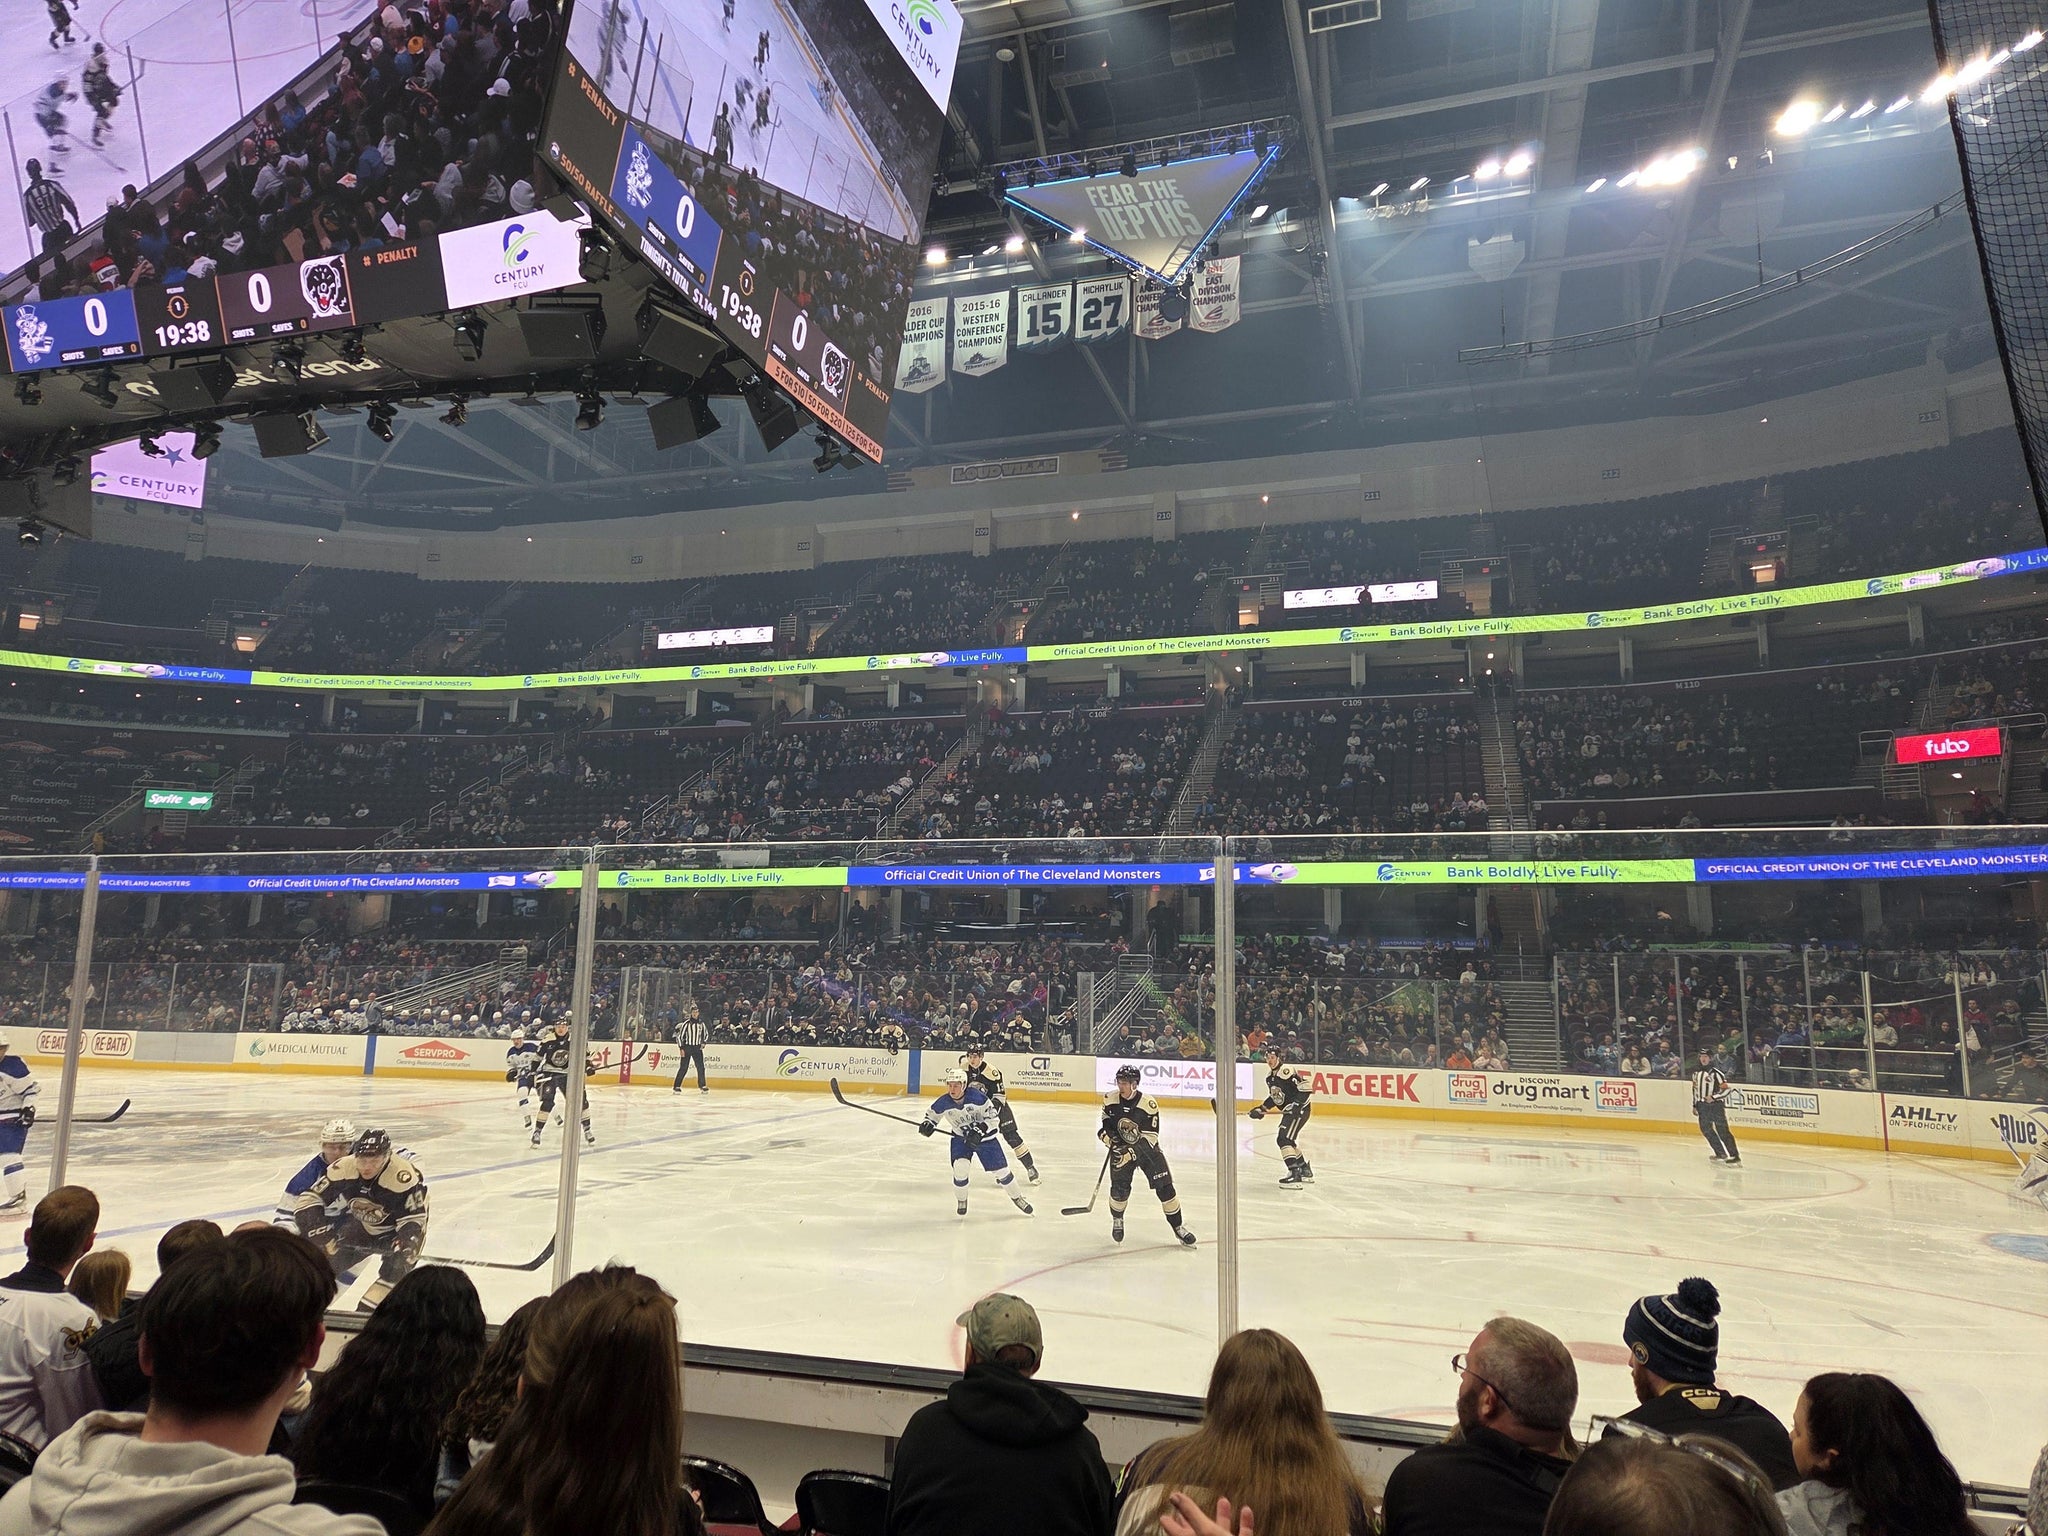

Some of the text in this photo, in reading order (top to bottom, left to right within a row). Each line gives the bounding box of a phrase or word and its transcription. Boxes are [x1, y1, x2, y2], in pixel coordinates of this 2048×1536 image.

[891, 3, 941, 79] CENTURY
[906, 43, 921, 69] FCU
[580, 77, 617, 126] PENALTY
[560, 154, 614, 218] 50/50 RAFFLE
[1085, 179, 1184, 207] FEAR THE
[676, 195, 695, 239] 0
[1094, 199, 1204, 241] DEPTHS
[377, 246, 418, 265] PENALTY
[494, 264, 545, 285] CENTURY
[671, 267, 690, 295] TOTAL
[1206, 275, 1223, 285] EAST
[248, 272, 271, 313] 0
[513, 281, 528, 290] FCU
[1083, 282, 1124, 295] MICHAYLUK
[1198, 284, 1231, 296] DIVISION
[1022, 289, 1067, 302] CALLANDER
[1193, 292, 1236, 306] CHAMPIONS
[721, 285, 762, 339] 19:38
[910, 306, 932, 317] 2016
[962, 299, 1001, 313] 2015-16
[1082, 295, 1123, 331] 27
[84, 298, 108, 336] 0
[929, 317, 945, 329] CUP
[963, 313, 1000, 326] WESTERN
[1026, 302, 1062, 337] 15
[155, 320, 210, 347] 19:38
[232, 327, 255, 338] SHOTS
[792, 314, 807, 351] 0
[956, 323, 1005, 337] CONFERENCE
[958, 335, 1003, 348] CHAMPIONS
[62, 351, 85, 361] SHOTS
[865, 378, 890, 404] PENALTY
[780, 370, 794, 388] FOR
[807, 396, 817, 411] 50
[817, 402, 830, 421] FOR
[845, 425, 856, 442] 125
[856, 433, 868, 450] FOR
[119, 475, 199, 496] CENTURY
[147, 490, 169, 500] FCU
[1157, 512, 1171, 520] 210
[975, 528, 989, 536] 209
[1644, 609, 1673, 620] Bank
[1676, 604, 1718, 616] Boldly.
[1721, 601, 1747, 610] Live
[1750, 594, 1785, 606] Fully.
[1390, 627, 1416, 637] Bank
[1419, 624, 1455, 636] Boldly.
[1458, 623, 1480, 633] Live
[1483, 621, 1513, 632] Fully.
[1053, 635, 1271, 656] Official Credit Union of The Cleveland Monsters
[961, 653, 979, 662] Live
[981, 651, 1005, 662] Fully.
[1925, 739, 1970, 755] fubo
[149, 793, 183, 804] Sprite
[1707, 853, 2048, 874] OFFICIAL CREDIT UNION OF THE CLEVELAND MONSTER
[664, 874, 690, 883] Bank
[693, 873, 729, 885] Boldly.
[731, 873, 754, 883] Live
[756, 872, 785, 884] Fully.
[884, 867, 1161, 881] Official Credit Union of The Cleveland Monsters
[1447, 866, 1483, 878] Bank
[1488, 866, 1540, 880] Boldly.
[1545, 866, 1576, 877] Live
[1581, 865, 1622, 879] Fully.
[12, 876, 42, 884] CREDIT
[43, 877, 69, 885] UNION
[69, 877, 79, 885] OF
[109, 879, 149, 887] CLEVELAND
[149, 880, 191, 888] MONSTERS
[248, 876, 460, 888] Official Credit Union of The Cleveland Monsters
[95, 1035, 128, 1051] RE-BATH
[267, 1042, 348, 1055] MEDICAL MUTUAL
[801, 1061, 847, 1071] CENTURY
[849, 1056, 898, 1067] Bank Boldly.
[848, 1067, 888, 1077] Live Fully.
[1018, 1070, 1049, 1078] CONSUMER
[1451, 1077, 1481, 1090] drug
[1519, 1077, 1561, 1085] DISCOUNT
[1455, 1089, 1486, 1099] mart
[1492, 1080, 1590, 1102] drug mart
[1599, 1084, 1629, 1098] drug
[1602, 1096, 1635, 1107] mart
[1747, 1093, 1816, 1110] HOME GENIUS
[1762, 1108, 1803, 1117] EXTERIORS
[1774, 1120, 1818, 1129] EXPERIENCE
[1889, 1119, 1900, 1127] ON
[1998, 1113, 2037, 1145] Blue
[1681, 1388, 1720, 1398] CCM
